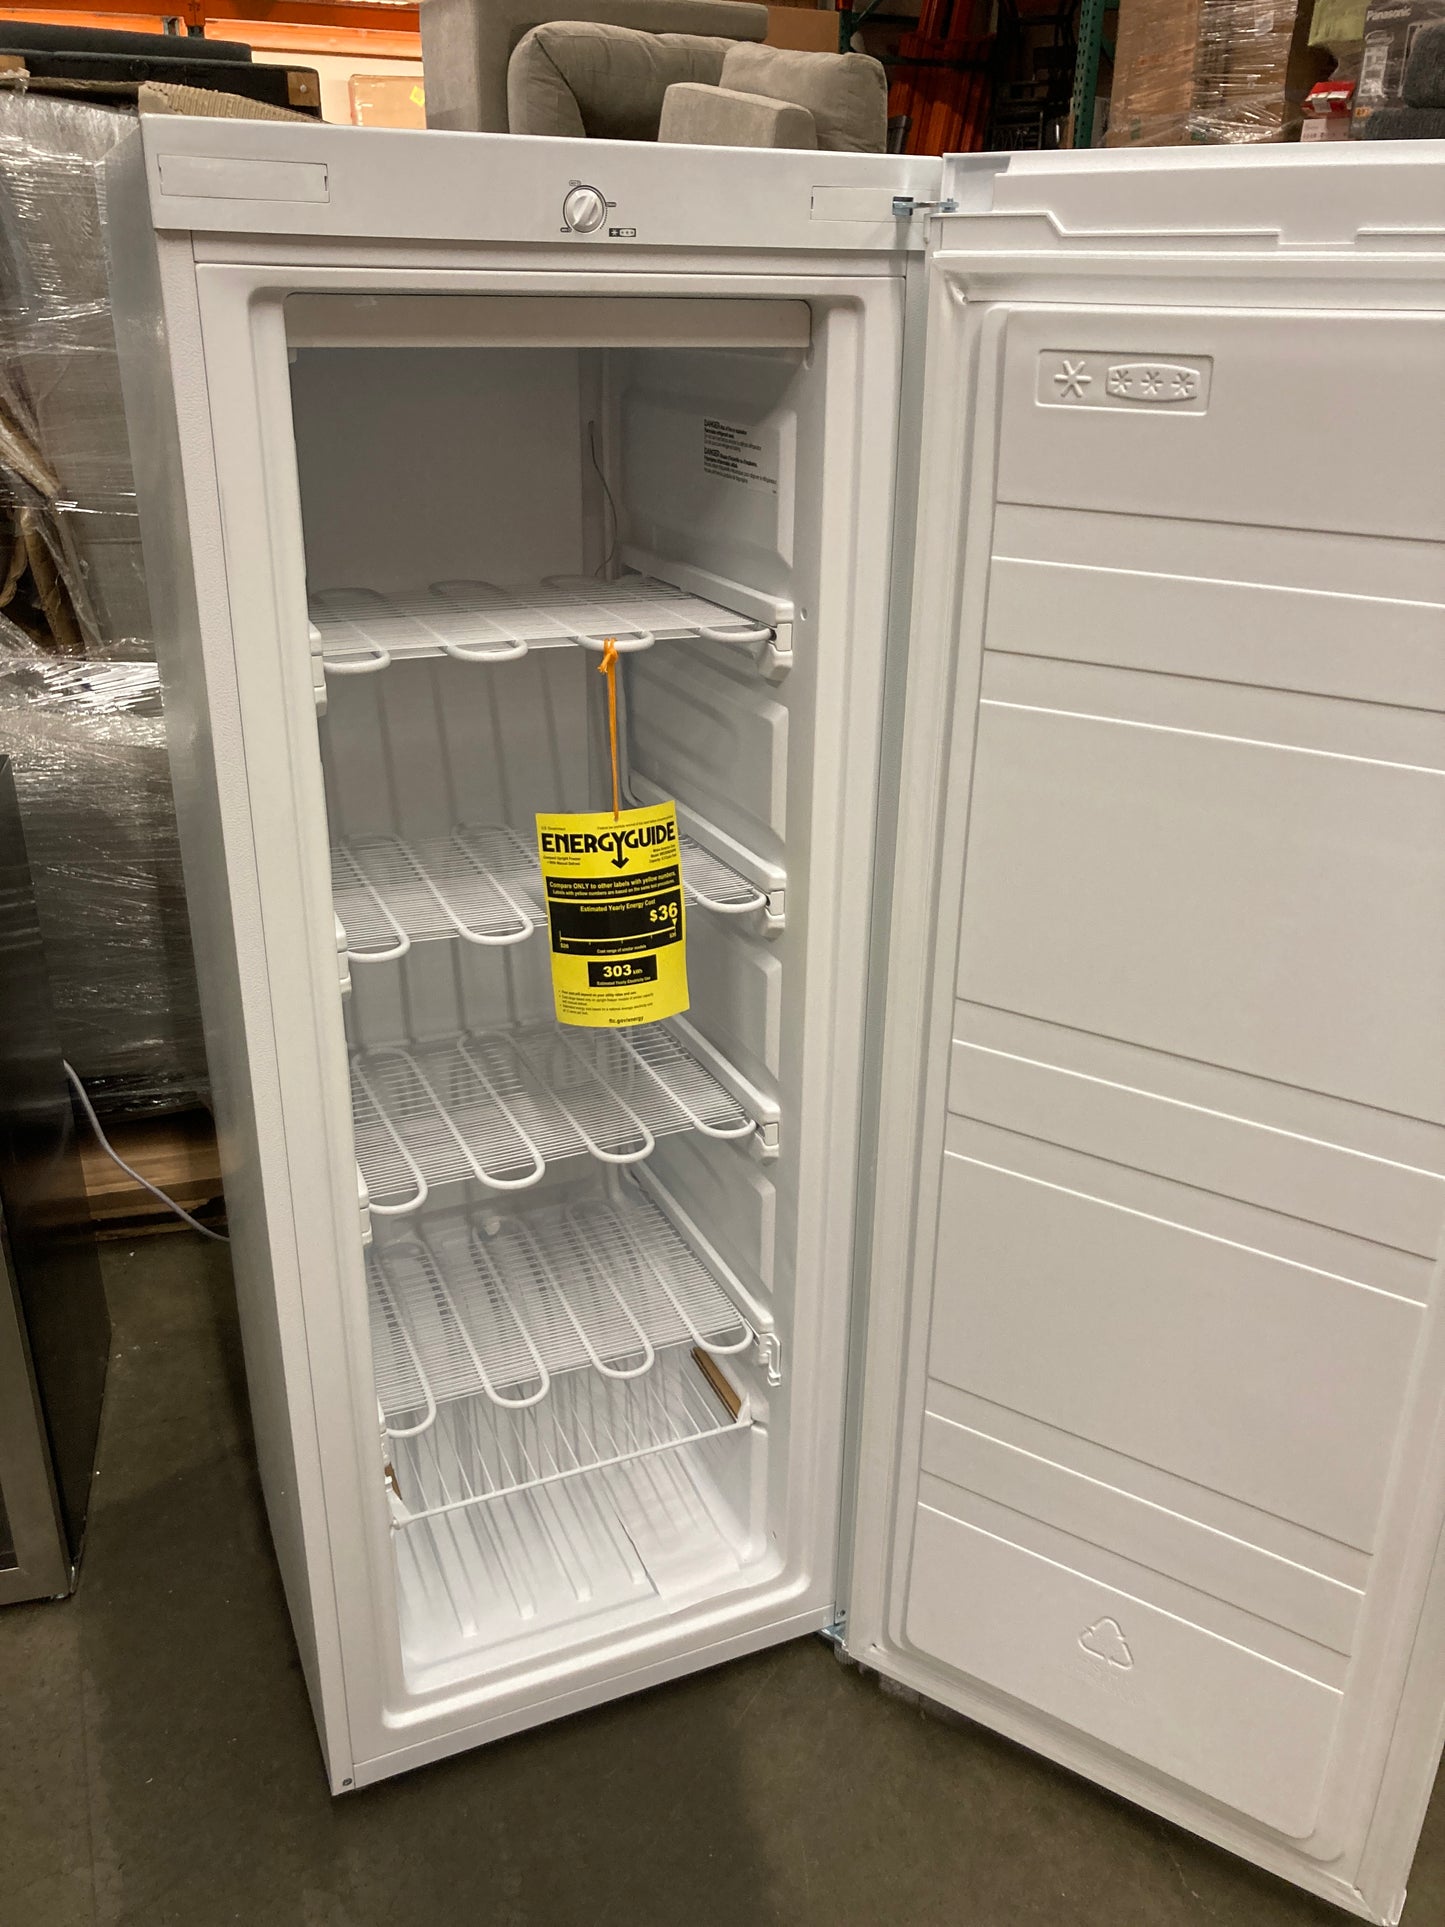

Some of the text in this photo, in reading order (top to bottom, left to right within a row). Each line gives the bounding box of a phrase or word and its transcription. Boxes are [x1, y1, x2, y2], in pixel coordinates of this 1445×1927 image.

[1366, 6, 1412, 21] Panasonic
[541, 821, 676, 854] ENERGYGUIDE
[573, 882, 589, 890] ONLY
[598, 882, 613, 890] other
[631, 878, 642, 886] with
[580, 905, 608, 913] Estimated
[626, 902, 643, 910] Energy
[650, 902, 677, 922] $36
[603, 964, 631, 978] 303
